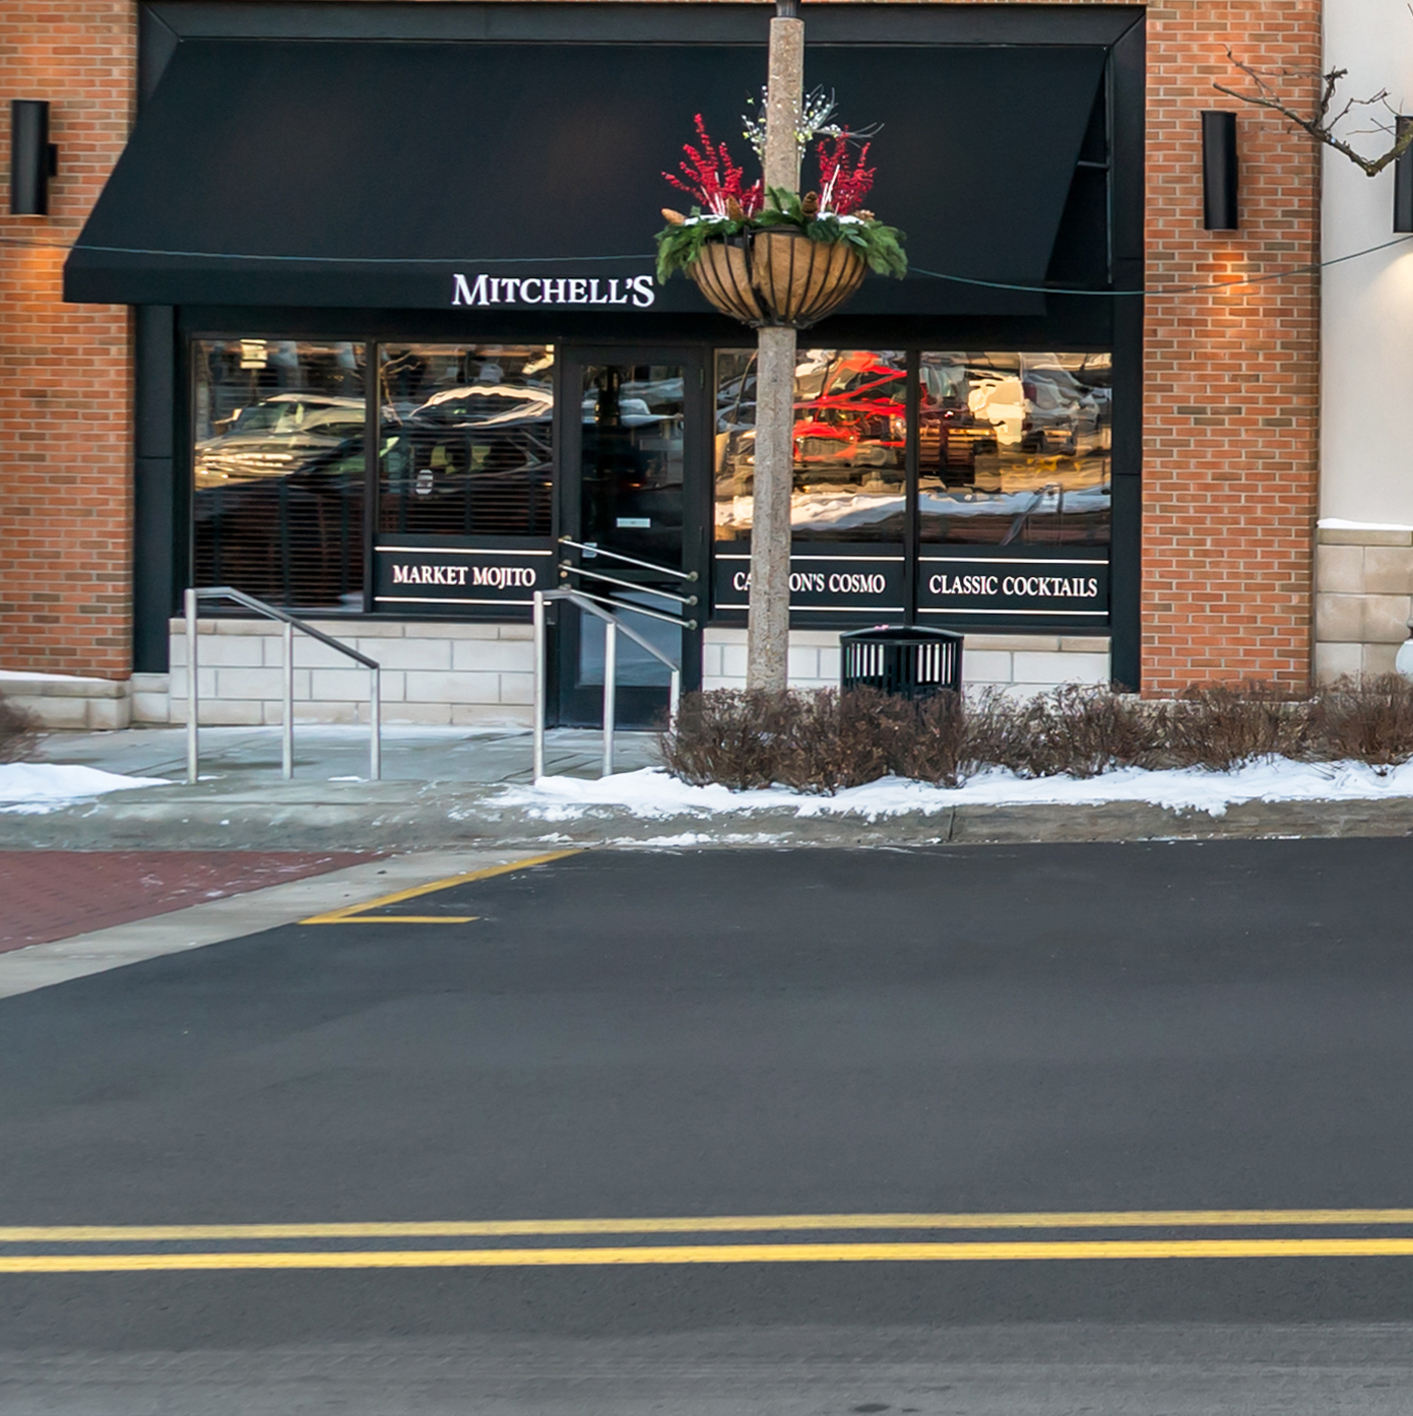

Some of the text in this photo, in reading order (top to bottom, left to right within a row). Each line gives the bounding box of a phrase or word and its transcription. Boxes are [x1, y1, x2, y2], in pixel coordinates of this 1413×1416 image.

[451, 273, 655, 308] MITCHELL'S
[392, 565, 536, 590] MARKET MOJITO
[828, 573, 886, 594] COSMO
[928, 574, 1098, 597] CLASSIC COCKTAILS
